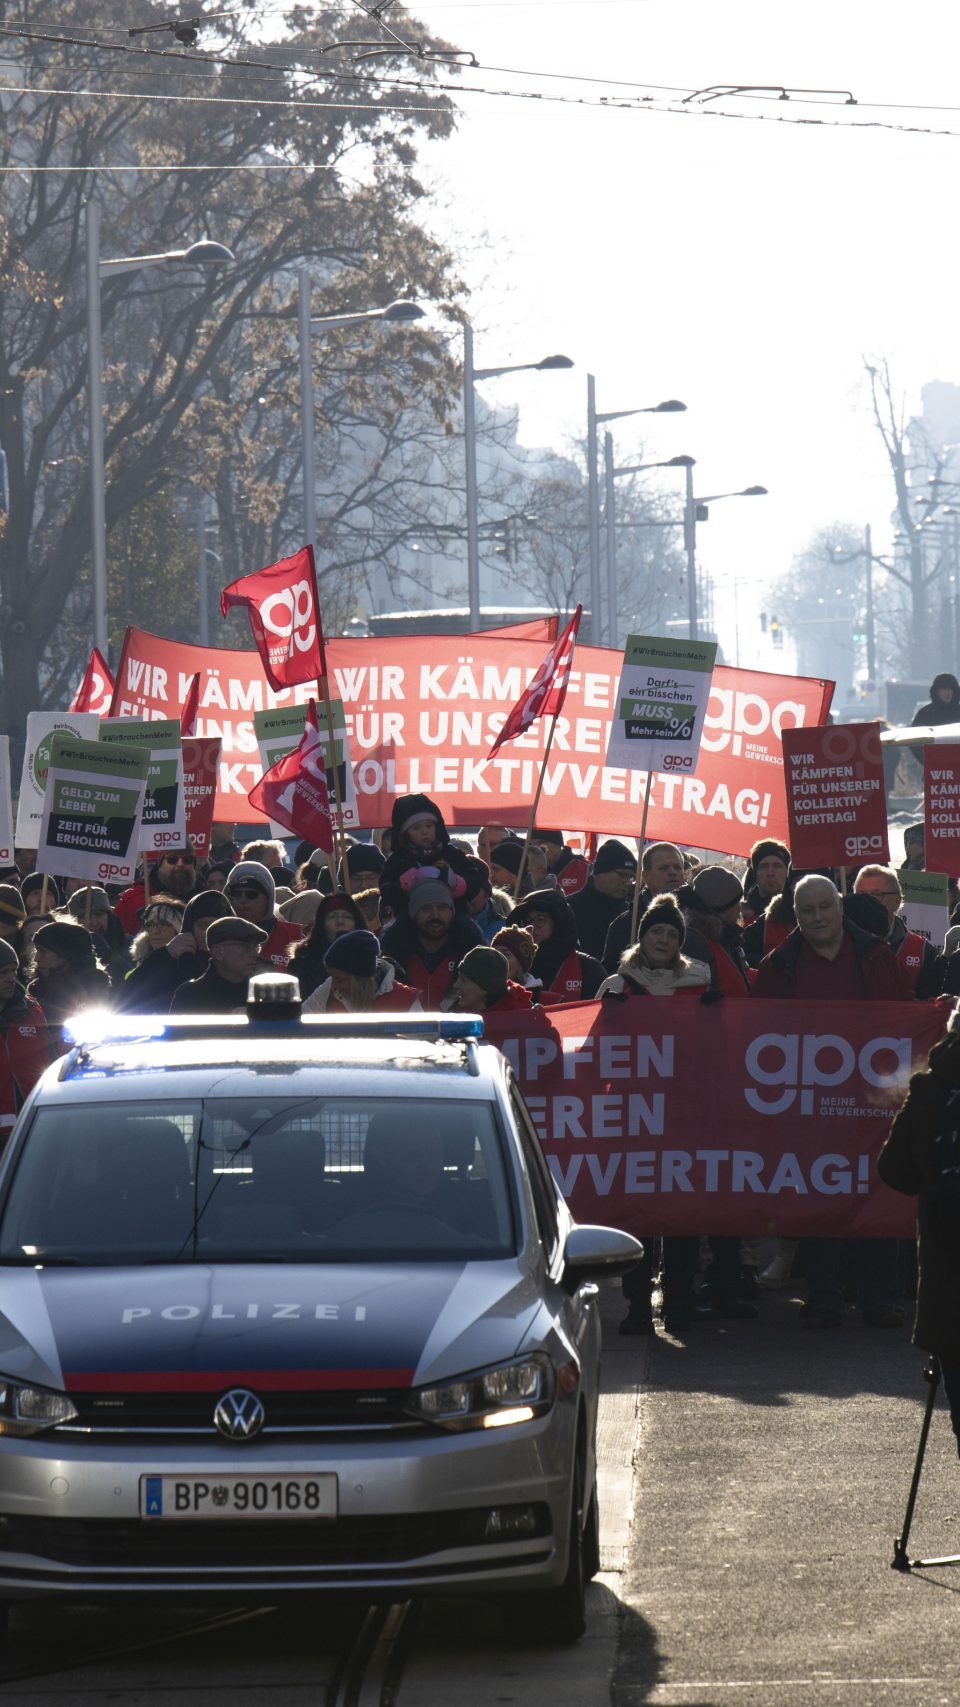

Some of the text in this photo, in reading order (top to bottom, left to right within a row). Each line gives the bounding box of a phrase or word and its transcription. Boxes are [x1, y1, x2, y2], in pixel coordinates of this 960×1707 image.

[633, 647, 708, 661] #WirBrauchenMehr
[127, 657, 168, 701] WIR
[334, 656, 620, 709] WIR KÄMFE
[646, 677, 679, 689] Darf's
[628, 688, 693, 702] ein bisschen
[631, 703, 674, 719] MUSS
[419, 711, 612, 755] UNSERE
[630, 717, 692, 738] Mehr sein %
[102, 731, 174, 742] #WirBrauchenMehr
[745, 743, 769, 754] MEINE
[60, 750, 141, 768] #WirBrauchenMehr
[662, 754, 694, 771] gpa
[744, 751, 784, 766] GEWERKSC
[790, 754, 815, 766] WIR
[791, 766, 853, 781] KÄMPFEN
[930, 769, 955, 781] WIR
[61, 786, 120, 804] GELD ZUM
[351, 757, 772, 828] OLLEKTIVVERTRAG!
[792, 779, 880, 795] FÜR UNSEREN
[59, 799, 96, 814] LEBEN
[794, 796, 868, 811] KOLLEKTIV-
[930, 797, 956, 809] FÜR
[794, 811, 857, 826] VERTRAG!
[58, 819, 108, 836] ZEIT FÜR
[56, 832, 120, 850] ERHOLUNG
[153, 831, 181, 848] gpa
[844, 835, 883, 857] gpa
[98, 862, 130, 880] gpa
[744, 1032, 913, 1116] gpa
[820, 1096, 856, 1107] MEINE
[121, 1303, 367, 1324] POLIZEI
[174, 1481, 320, 1511] BP 90168
[150, 1502, 158, 1511] A
